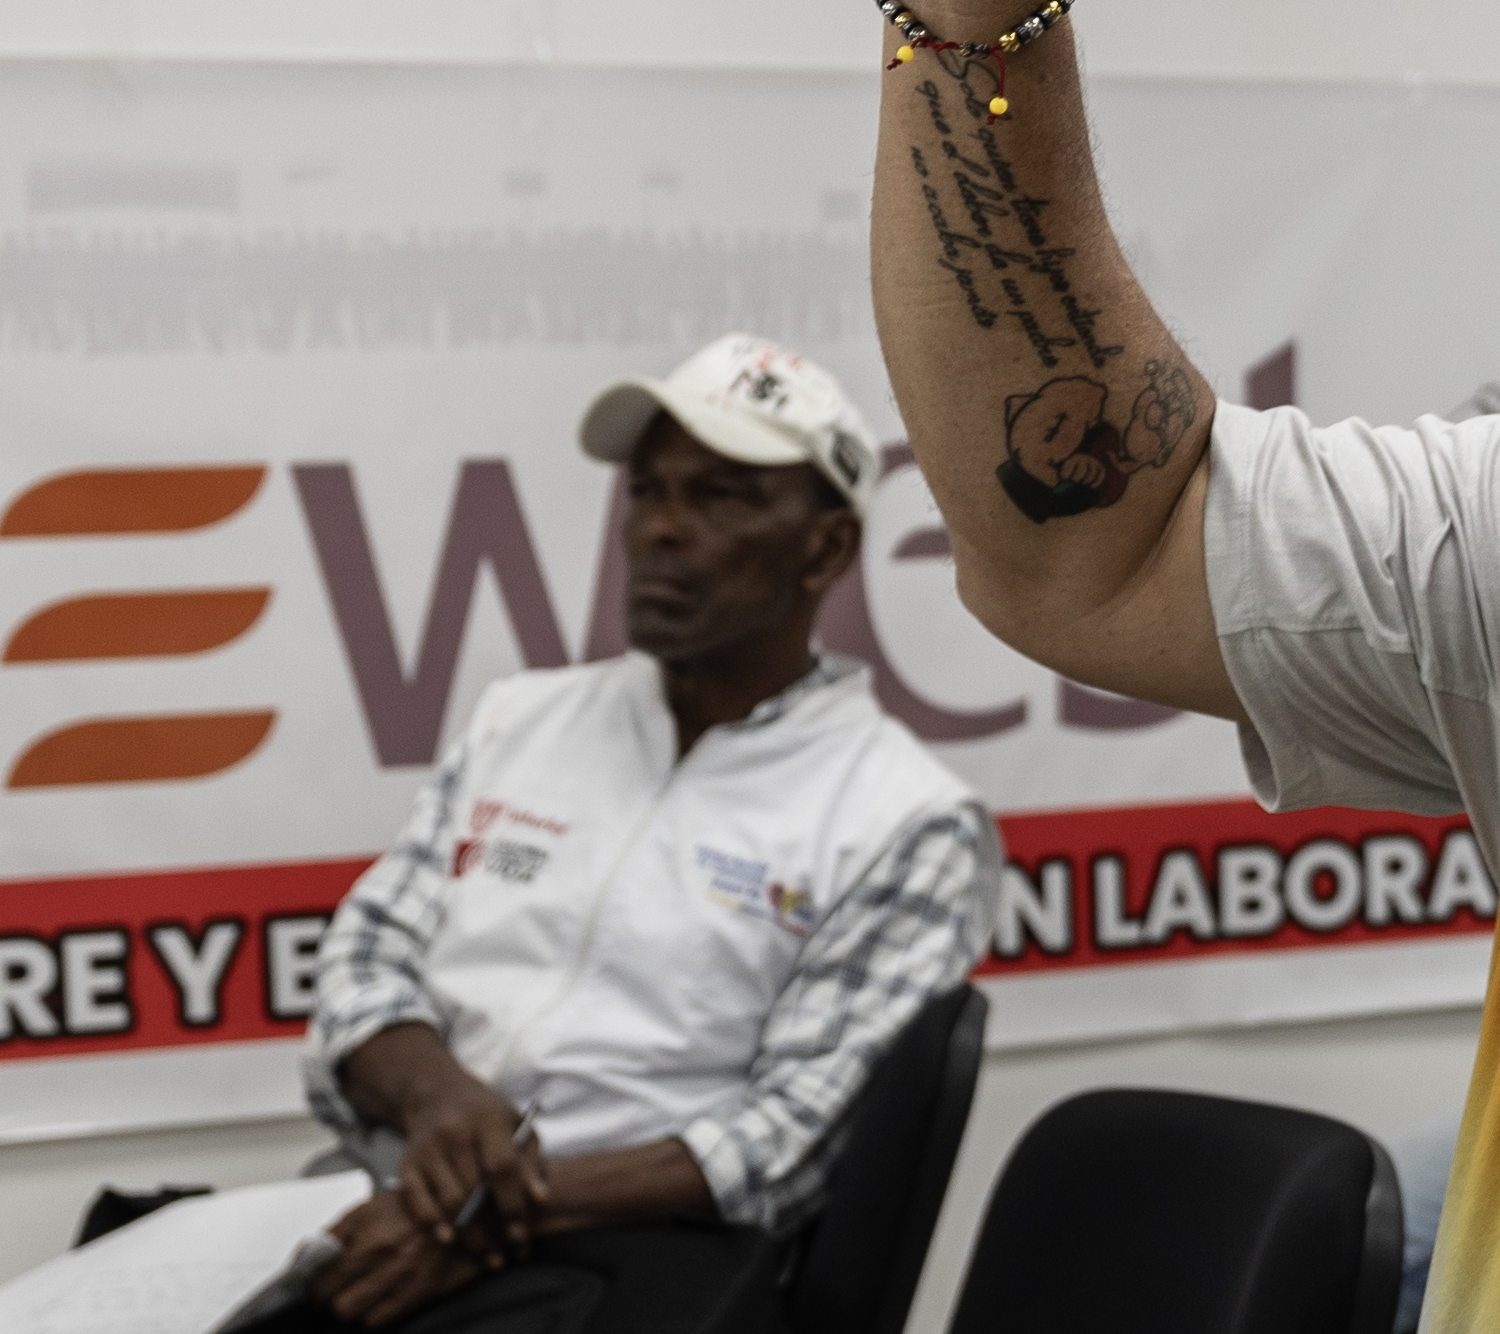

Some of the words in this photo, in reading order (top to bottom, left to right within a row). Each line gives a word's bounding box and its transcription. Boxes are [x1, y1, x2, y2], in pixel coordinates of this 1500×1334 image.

[915, 79, 952, 135] que
[151, 920, 242, 1025] Y
[1094, 829, 1499, 948] LABORA
